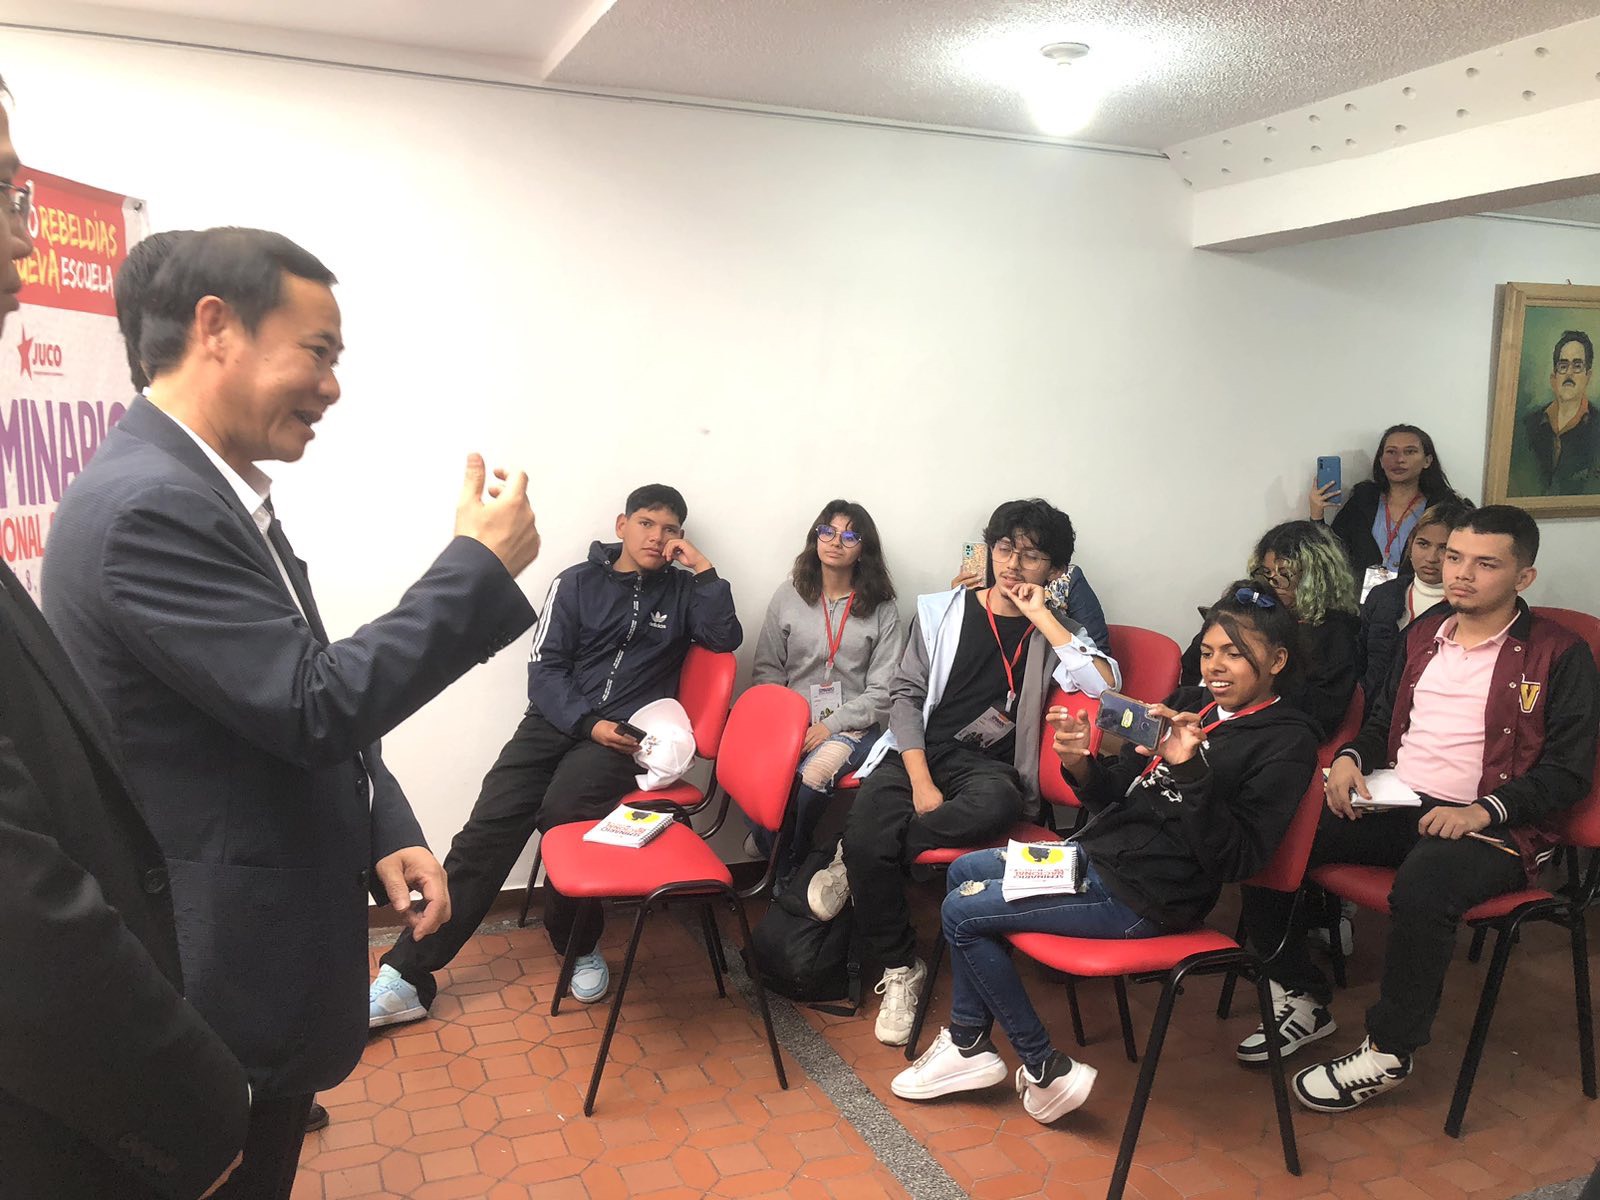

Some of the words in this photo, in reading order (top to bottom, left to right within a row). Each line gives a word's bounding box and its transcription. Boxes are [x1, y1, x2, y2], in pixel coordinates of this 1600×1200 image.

[15, 247, 60, 294] UEVA
[61, 256, 114, 299] ESCUELA
[32, 342, 62, 367] JUCO
[0, 398, 127, 508] MINAR
[1518, 681, 1541, 713] V
